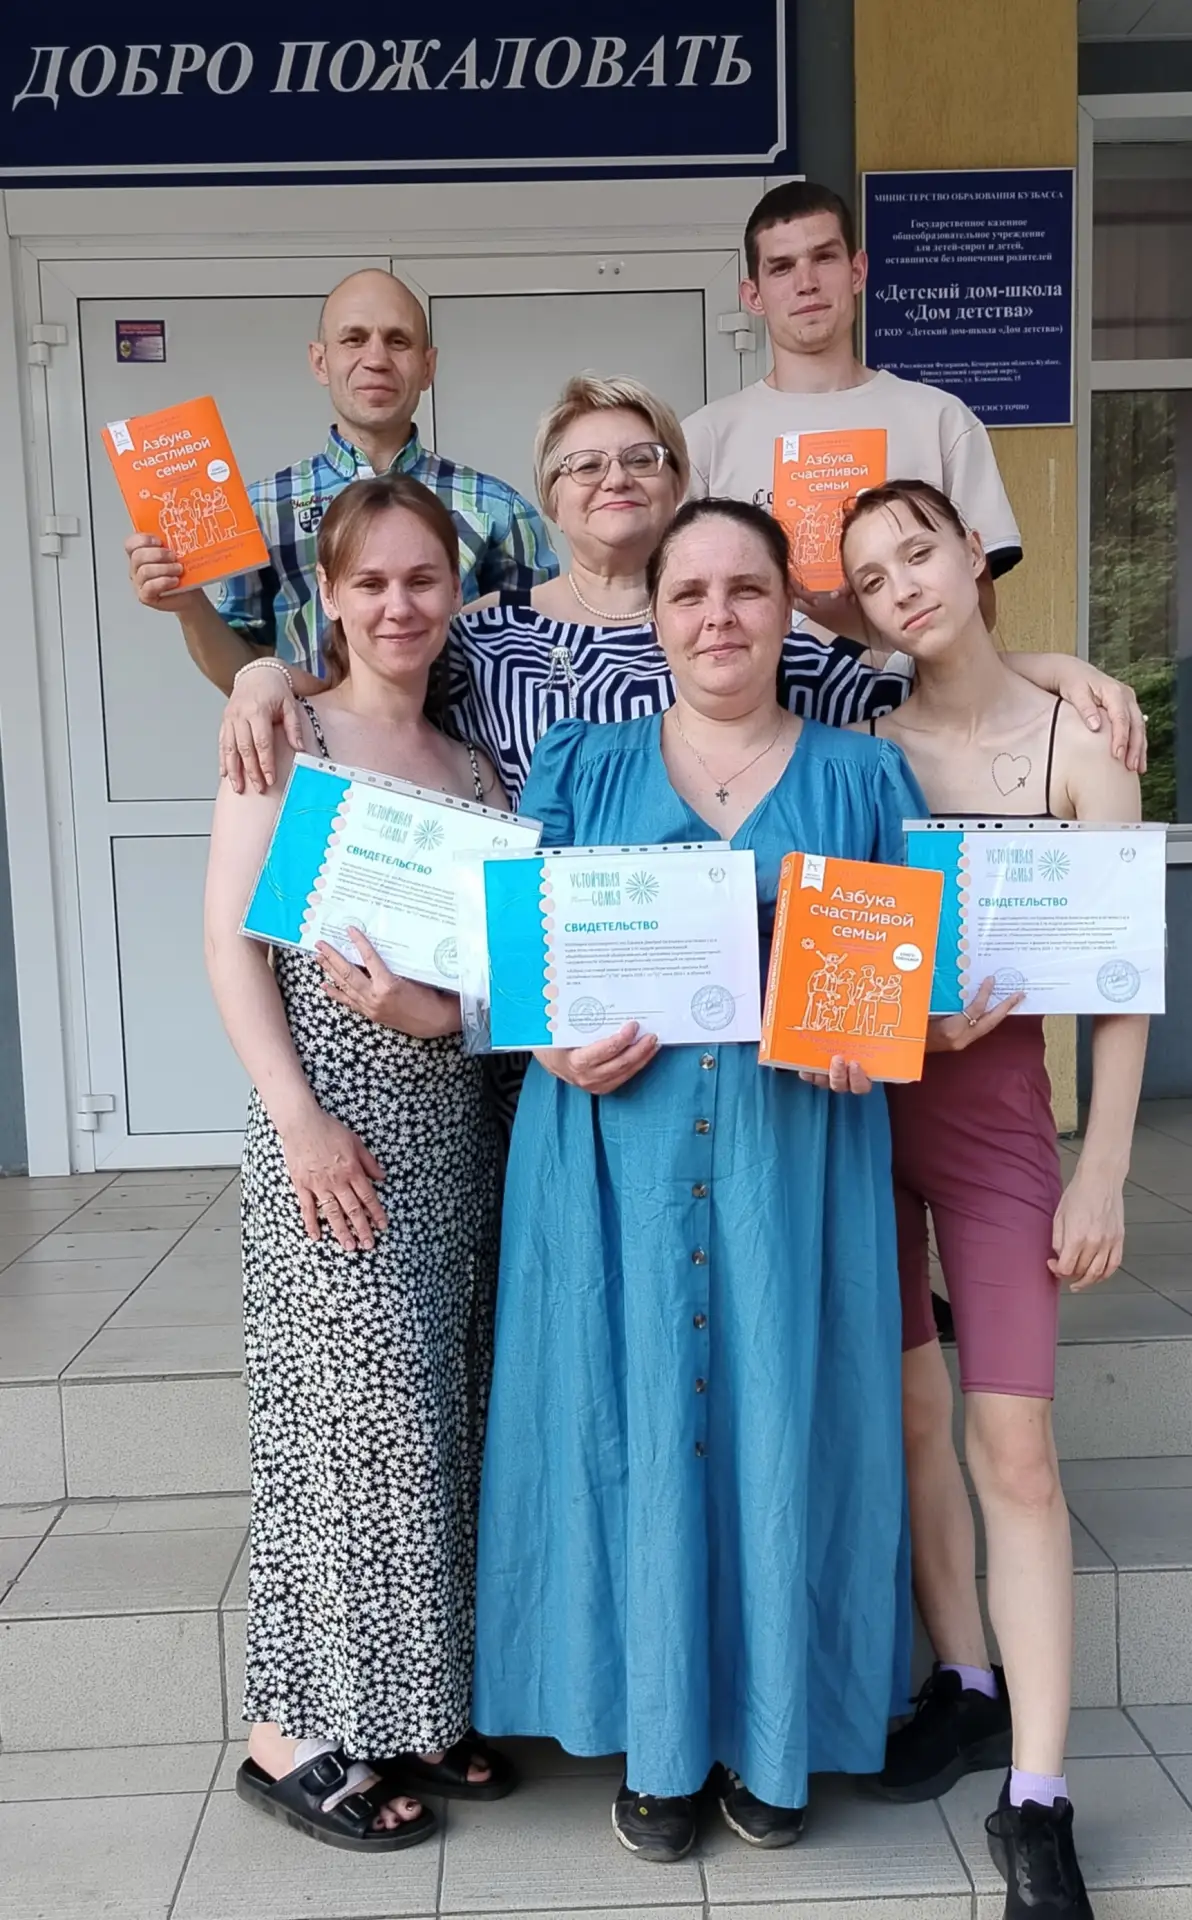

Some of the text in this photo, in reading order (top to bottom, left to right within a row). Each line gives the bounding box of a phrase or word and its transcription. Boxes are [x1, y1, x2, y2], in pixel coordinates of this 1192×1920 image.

[12, 35, 753, 111] ДОБРО ПОЖАЛОВАТЬ
[874, 190, 1064, 202] МИНИСТЕРСТВО ОБРАЗОВАНИЯ КУЗБАССА
[911, 219, 1028, 230] Государственное казенное
[892, 230, 1046, 241] общеобразовательное учреждение
[914, 244, 931, 252] для
[932, 242, 986, 253] детей-сирот
[885, 252, 1053, 265] оставшихся без попечения родителей
[875, 283, 1062, 302] «Детский дом-школа
[904, 304, 1033, 322] «Дом детства»
[875, 323, 1064, 338] (ГКОУ «Детский дом-школа «Дом детства»)
[142, 428, 193, 453] Азбука
[132, 436, 212, 471] счастливой
[805, 452, 854, 467] Азбука
[155, 458, 198, 479] семьи
[790, 464, 869, 481] счастливой
[808, 480, 850, 493] семьи
[366, 801, 414, 826] УСТОЙЧИВАЯ
[346, 844, 433, 876] СВИДЕТЕЛЬСТВО
[569, 870, 621, 888] УСТОЙЧИВАЯ
[830, 886, 896, 909] Азбука
[978, 897, 1068, 908] СВИДЕТЕЛЬСТВО
[809, 904, 914, 928] счастливой
[564, 920, 659, 934] СВИДЕТЕЛЬСТВО
[832, 925, 887, 942] семьи
